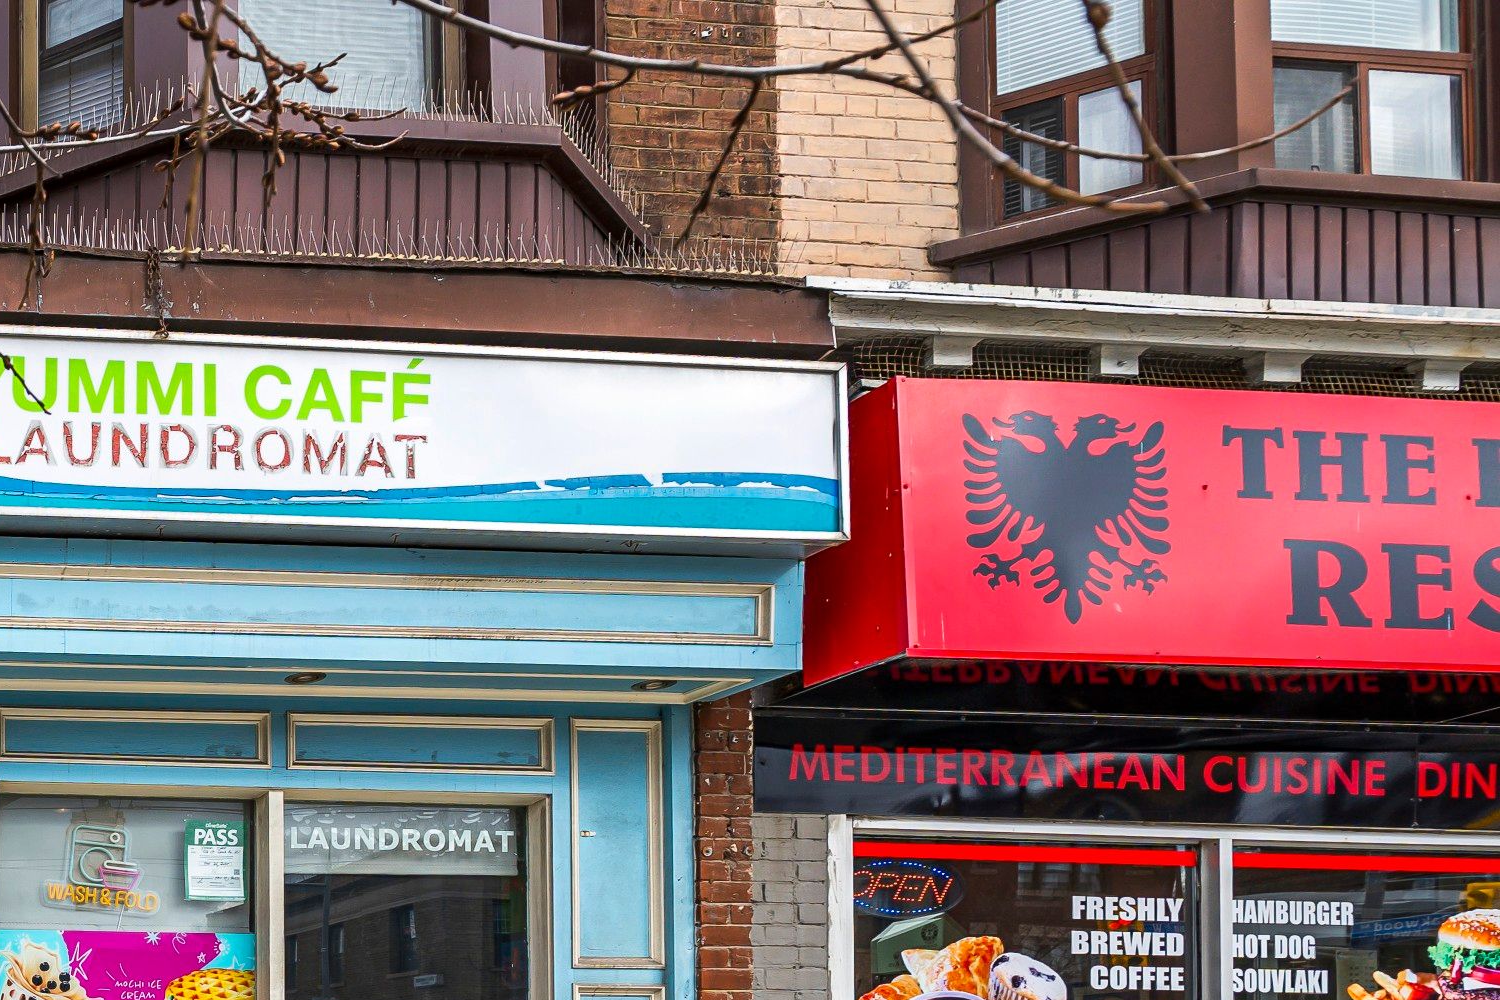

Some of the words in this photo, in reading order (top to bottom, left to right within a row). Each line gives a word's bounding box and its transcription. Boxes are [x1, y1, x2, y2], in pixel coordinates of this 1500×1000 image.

[244, 358, 431, 423] CAFÉ
[1221, 424, 1437, 506] THE
[788, 743, 1186, 792] MEDITERRANEAN
[1203, 755, 1386, 797] CUISINE
[1417, 761, 1498, 799] DIN
[194, 828, 239, 846] PASS
[290, 826, 515, 853] LAUNDROMAT
[47, 881, 97, 905] WASH
[100, 887, 112, 906] &
[114, 889, 159, 912] FOLD
[1071, 895, 1185, 922] FRESHLY
[1232, 899, 1355, 926] HAMBURGER
[1070, 930, 1185, 957] BREWED
[1232, 934, 1271, 959] HOT
[1274, 935, 1316, 959] DOG
[115, 980, 144, 988] MOCHI
[148, 980, 162, 989] ICE
[1090, 965, 1185, 991] COFFEE
[1232, 968, 1329, 994] SOUVLAKI
[121, 991, 155, 1000] CREAM
